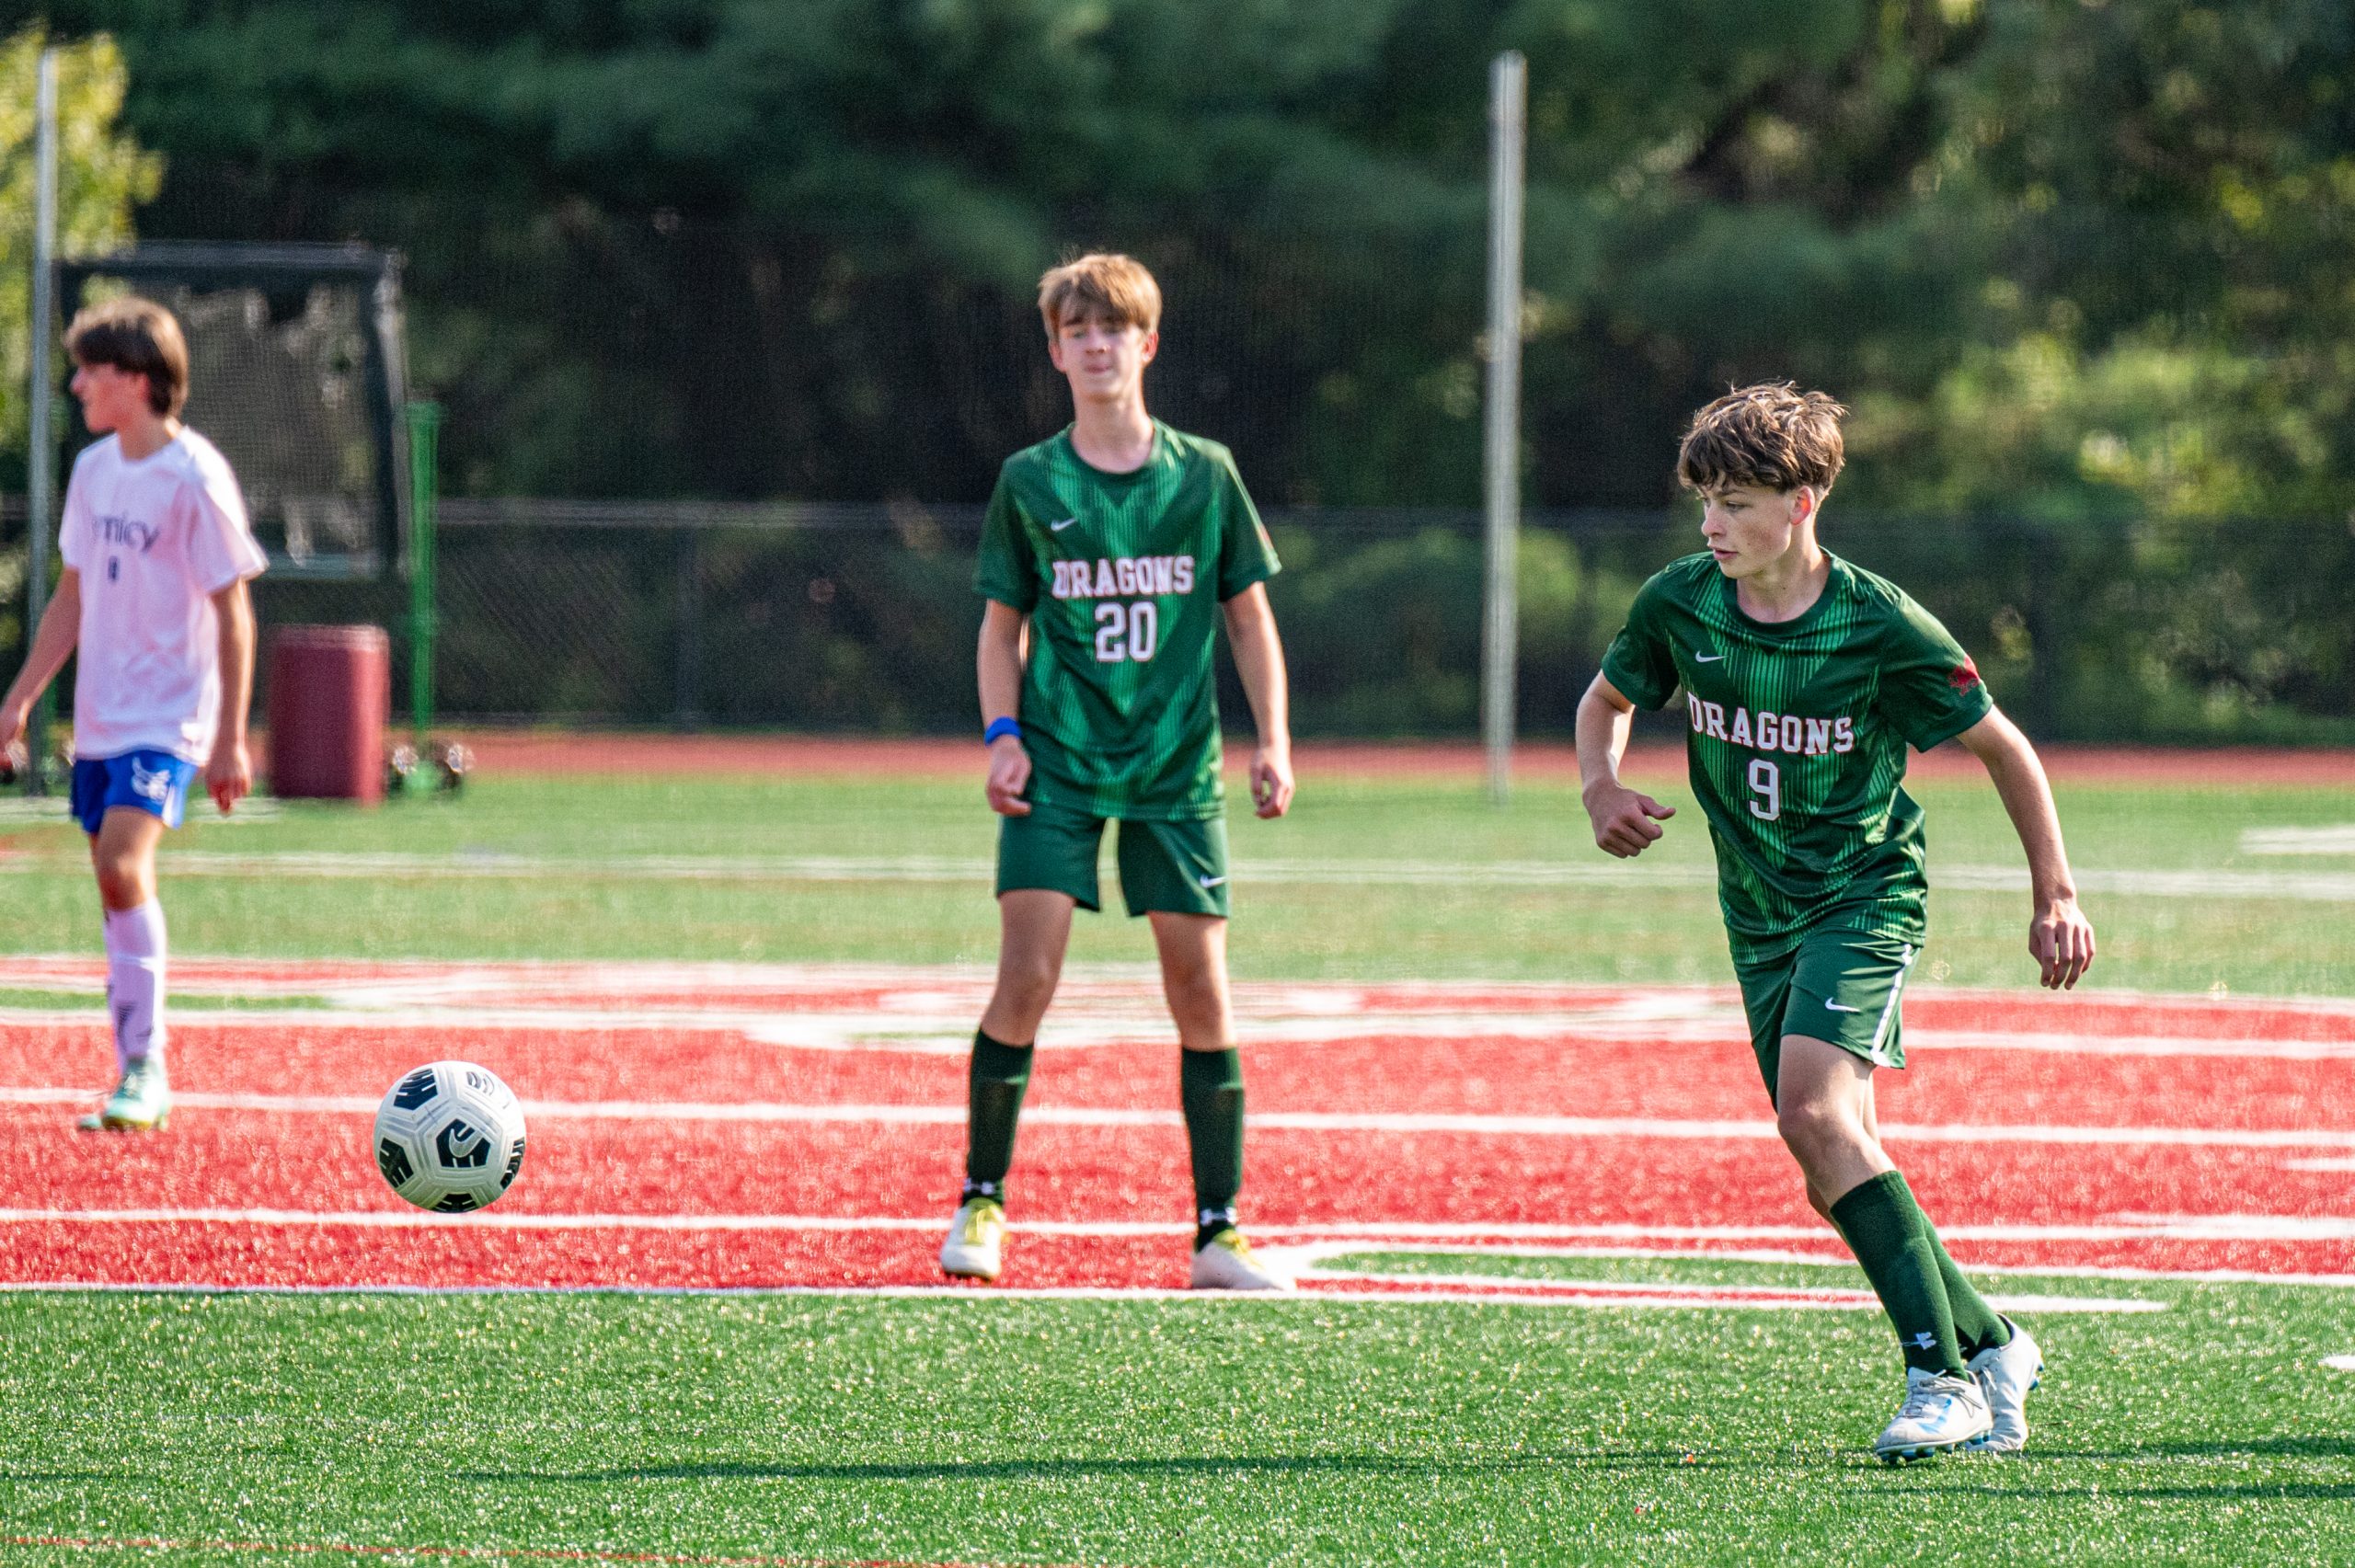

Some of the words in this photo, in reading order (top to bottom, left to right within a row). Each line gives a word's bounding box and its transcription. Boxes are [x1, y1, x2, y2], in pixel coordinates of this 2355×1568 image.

[1051, 555, 1195, 599] DRAGONS
[1095, 601, 1157, 662] 20
[1687, 691, 1855, 756] DRAGONS
[1748, 758, 1780, 821] 9
